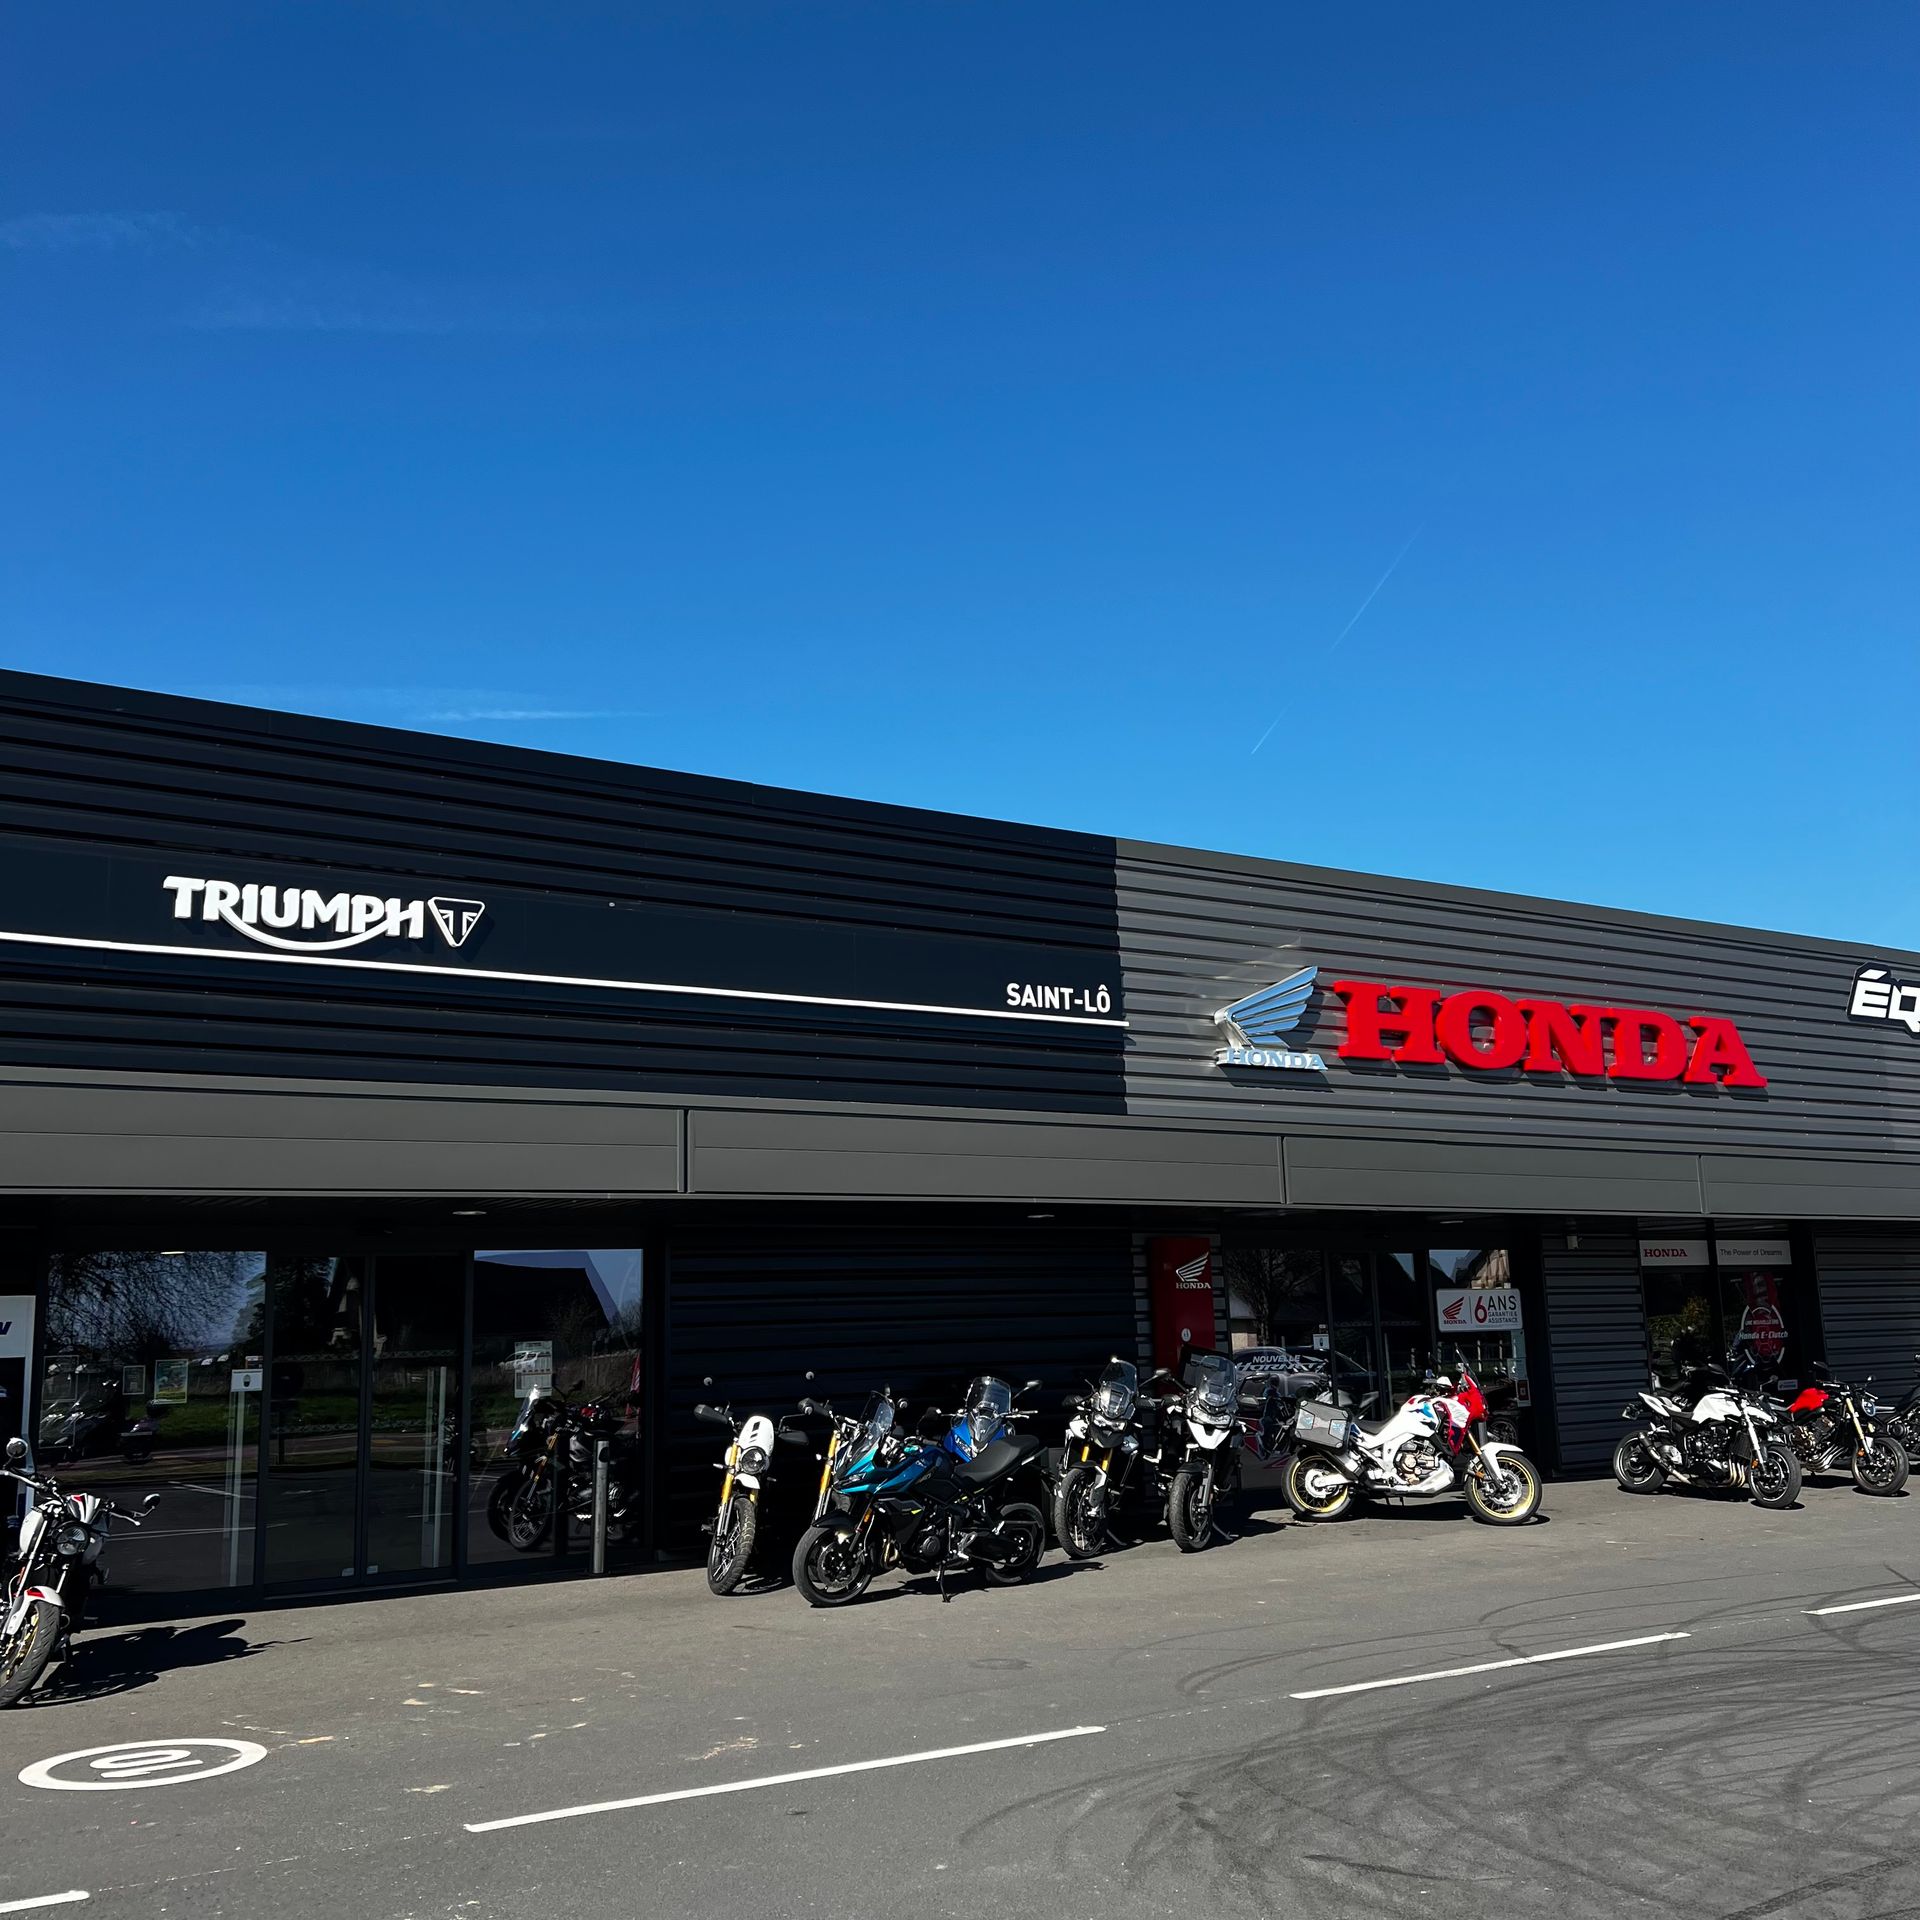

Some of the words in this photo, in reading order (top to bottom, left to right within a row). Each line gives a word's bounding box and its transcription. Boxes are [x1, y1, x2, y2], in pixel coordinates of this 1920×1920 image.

[163, 875, 424, 951] TRIUMPH
[1006, 982, 1111, 1014] SAINT-LÔ
[1333, 980, 1768, 1088] HONDA
[1226, 1048, 1328, 1071] HONDA
[1643, 1248, 1688, 1258] HONDA
[1176, 1282, 1211, 1290] HONDA
[1475, 1295, 1487, 1323] 6
[1488, 1295, 1517, 1310] ANS
[1252, 1354, 1301, 1363] NOUVELLE
